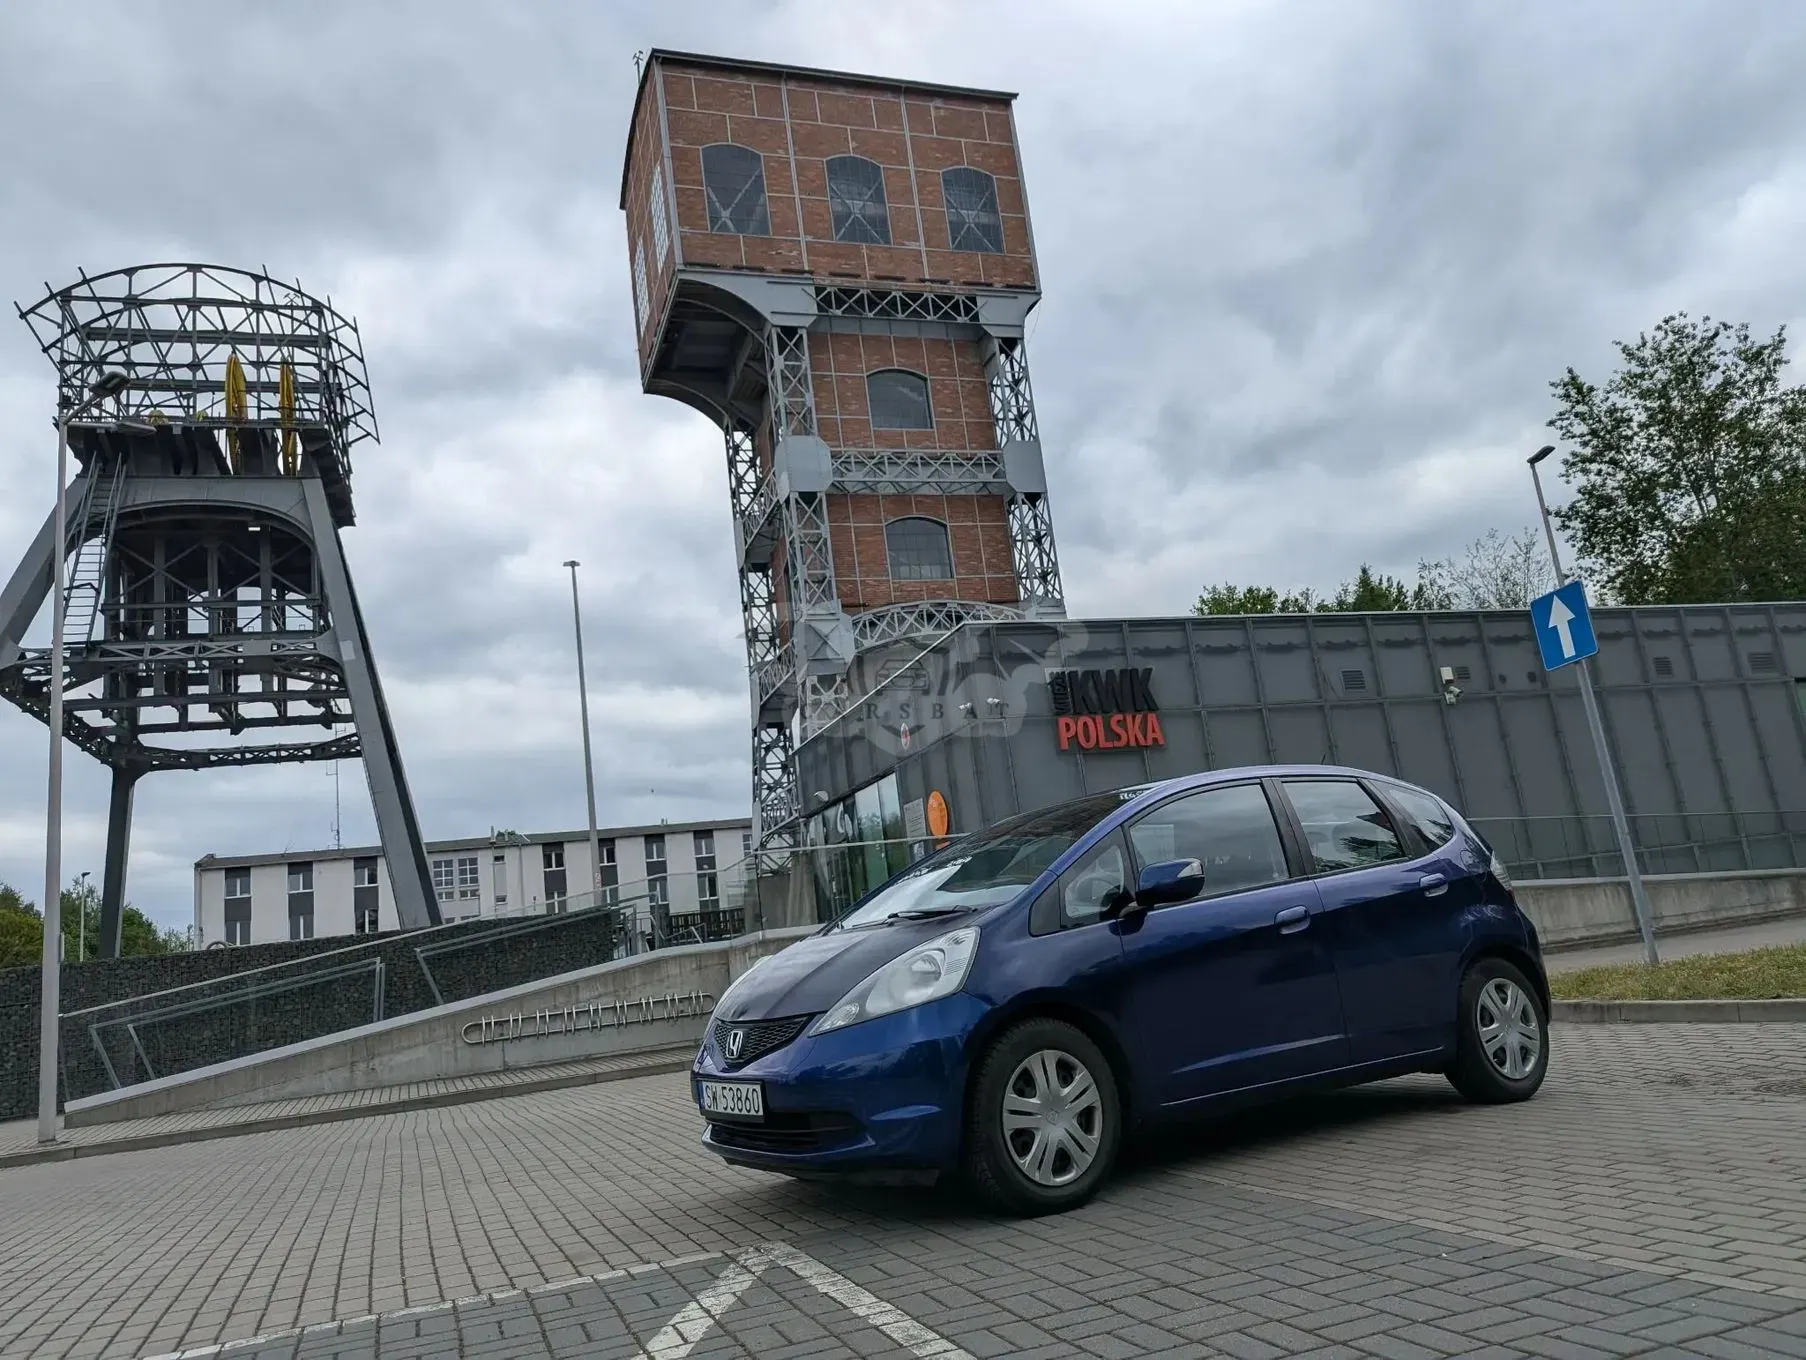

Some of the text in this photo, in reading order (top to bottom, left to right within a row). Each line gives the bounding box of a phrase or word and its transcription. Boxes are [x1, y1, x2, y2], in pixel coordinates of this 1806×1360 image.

[1068, 667, 1159, 714] KWK
[1058, 713, 1165, 751] POLSKA
[721, 1086, 760, 1114] 53860
